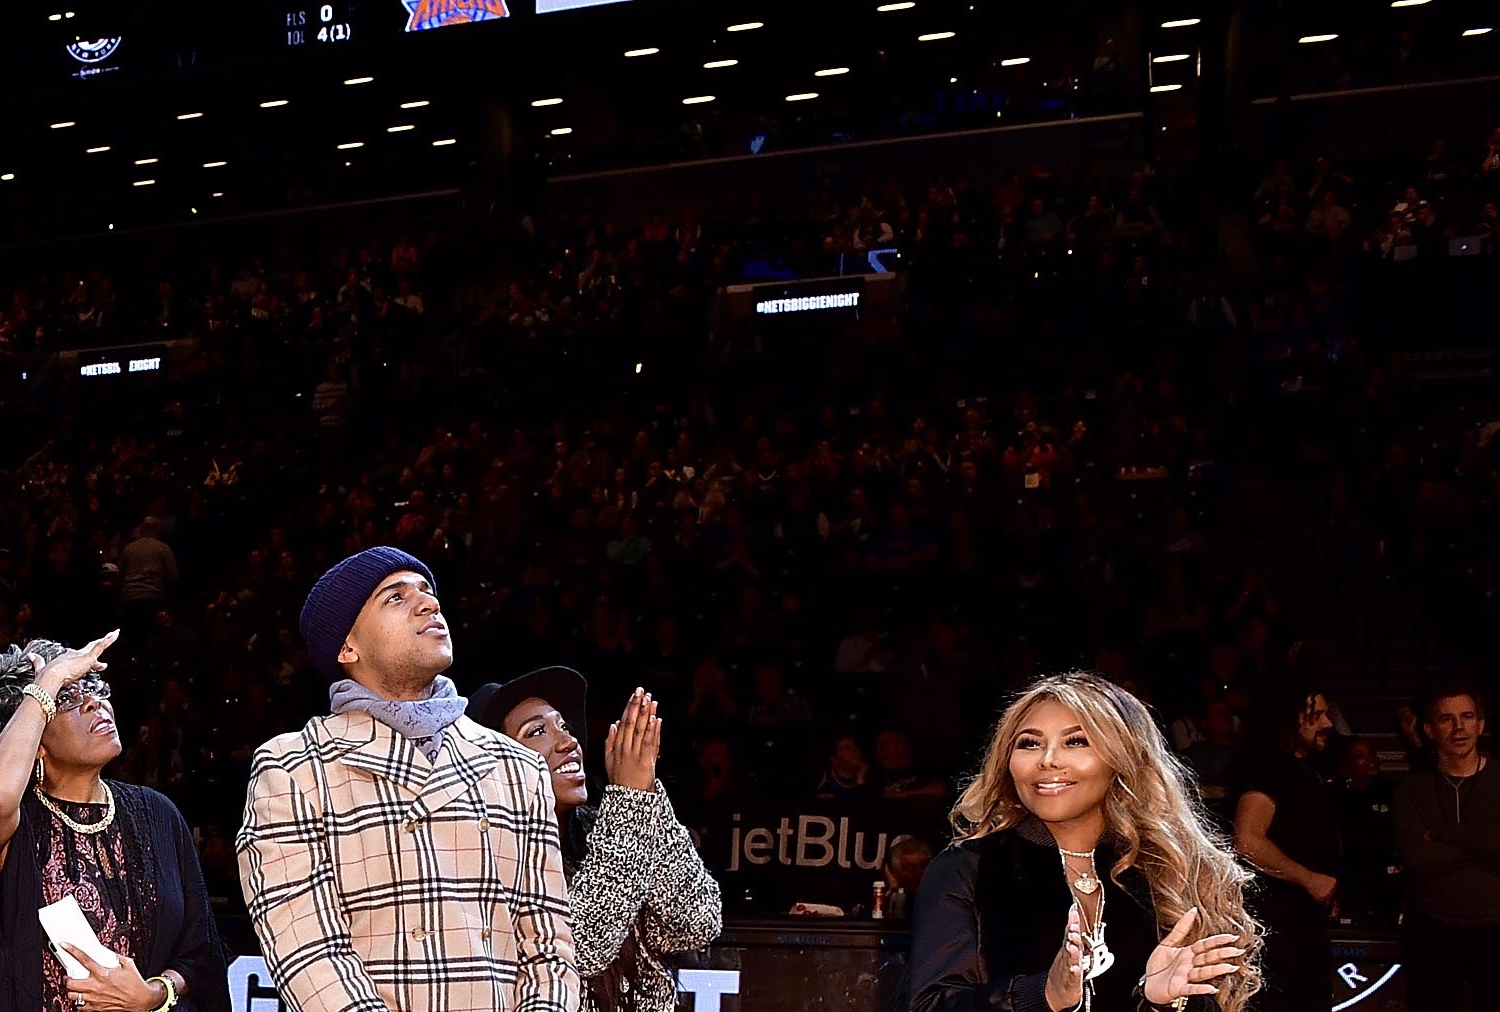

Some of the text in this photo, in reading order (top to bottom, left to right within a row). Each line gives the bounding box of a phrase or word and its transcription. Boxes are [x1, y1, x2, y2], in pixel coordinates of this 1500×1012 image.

[286, 4, 333, 27] FLS 0
[317, 22, 351, 43] 4(1)
[756, 292, 860, 314] #NETSBIGGIENIGHT
[724, 812, 913, 872] jetBlu
